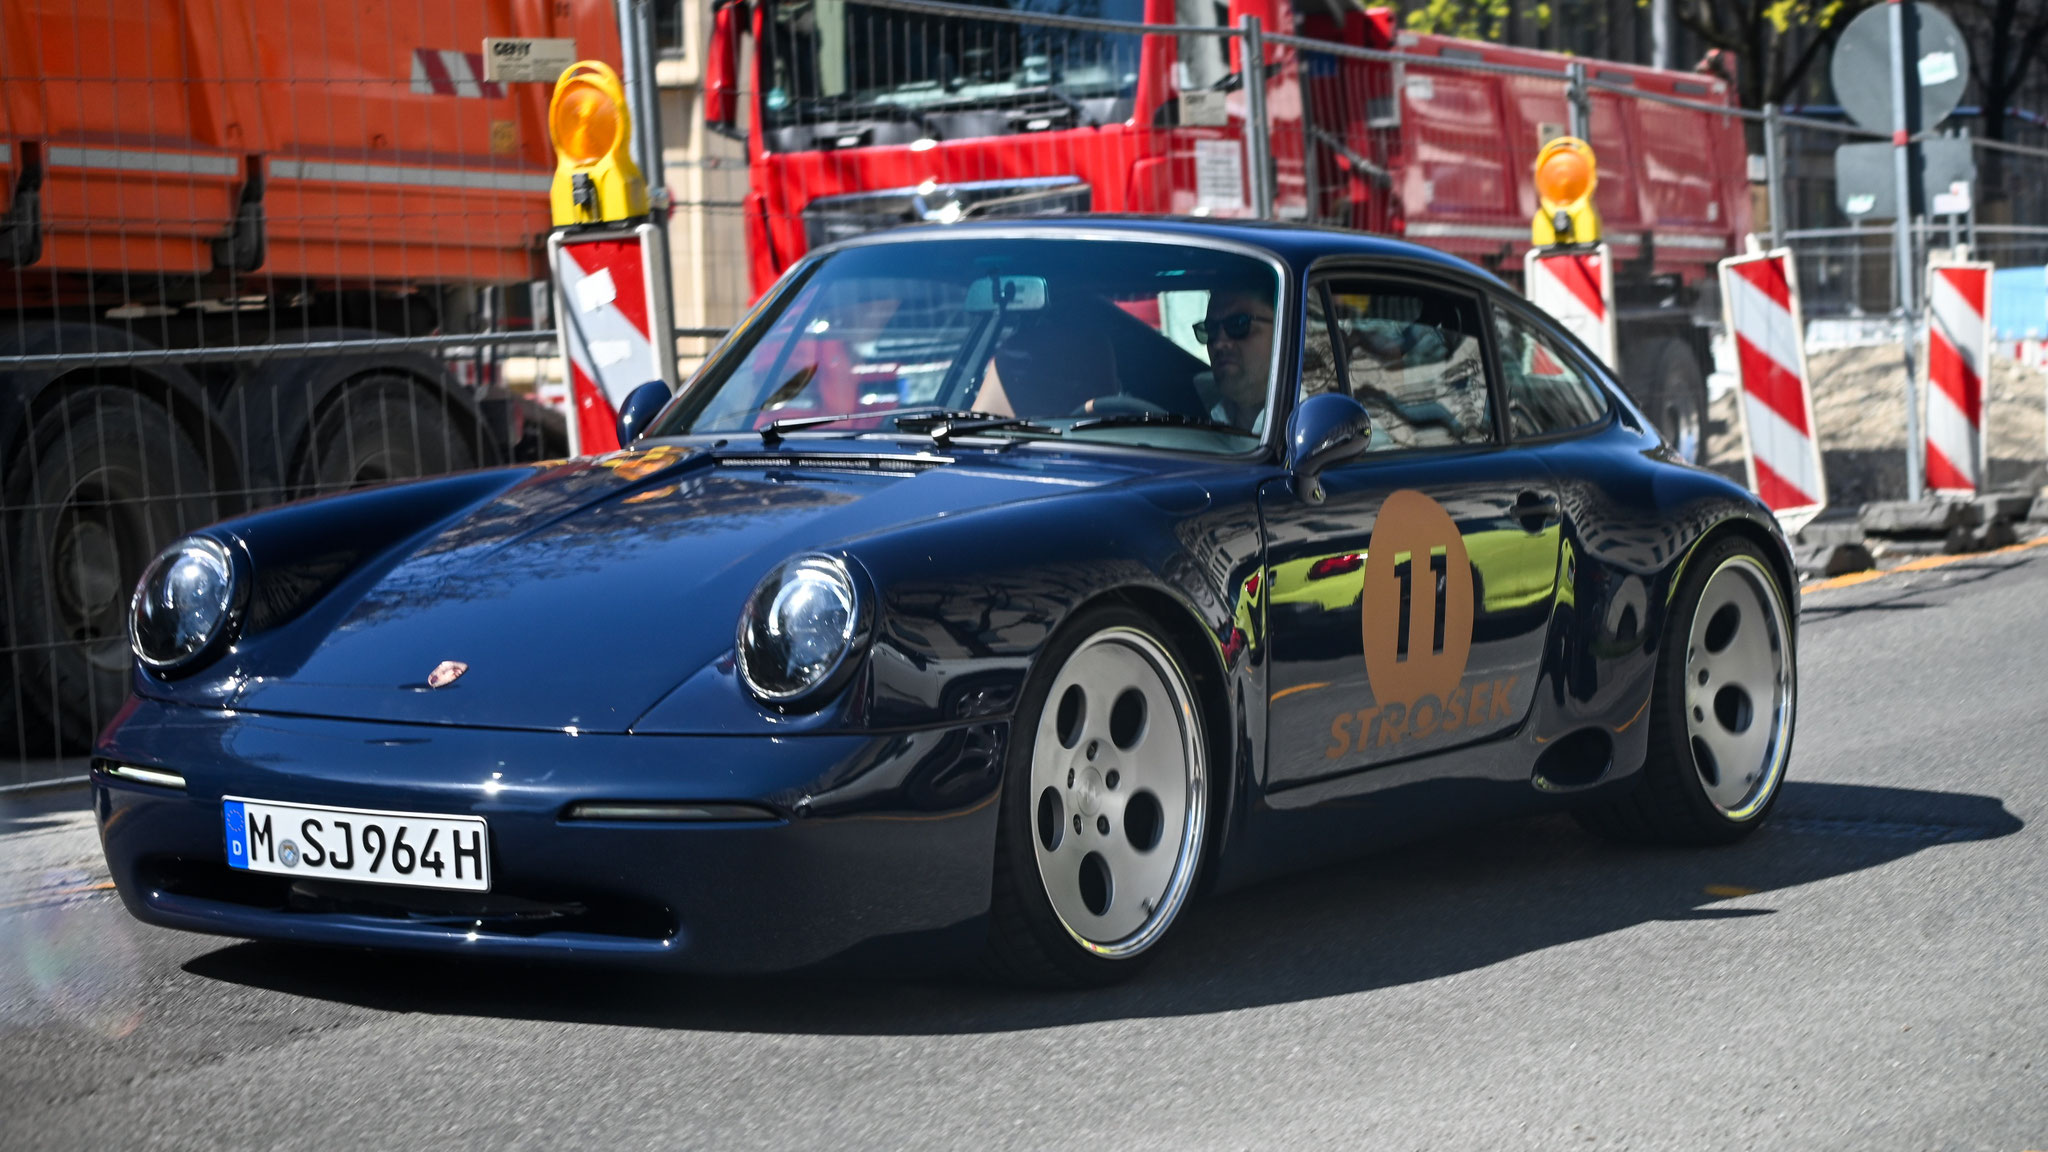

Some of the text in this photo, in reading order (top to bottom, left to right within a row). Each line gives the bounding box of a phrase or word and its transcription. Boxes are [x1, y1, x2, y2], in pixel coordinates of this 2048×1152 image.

[1394, 544, 1447, 664] 11
[1325, 676, 1522, 759] STROSEK
[232, 840, 242, 856] D
[249, 812, 275, 863] M
